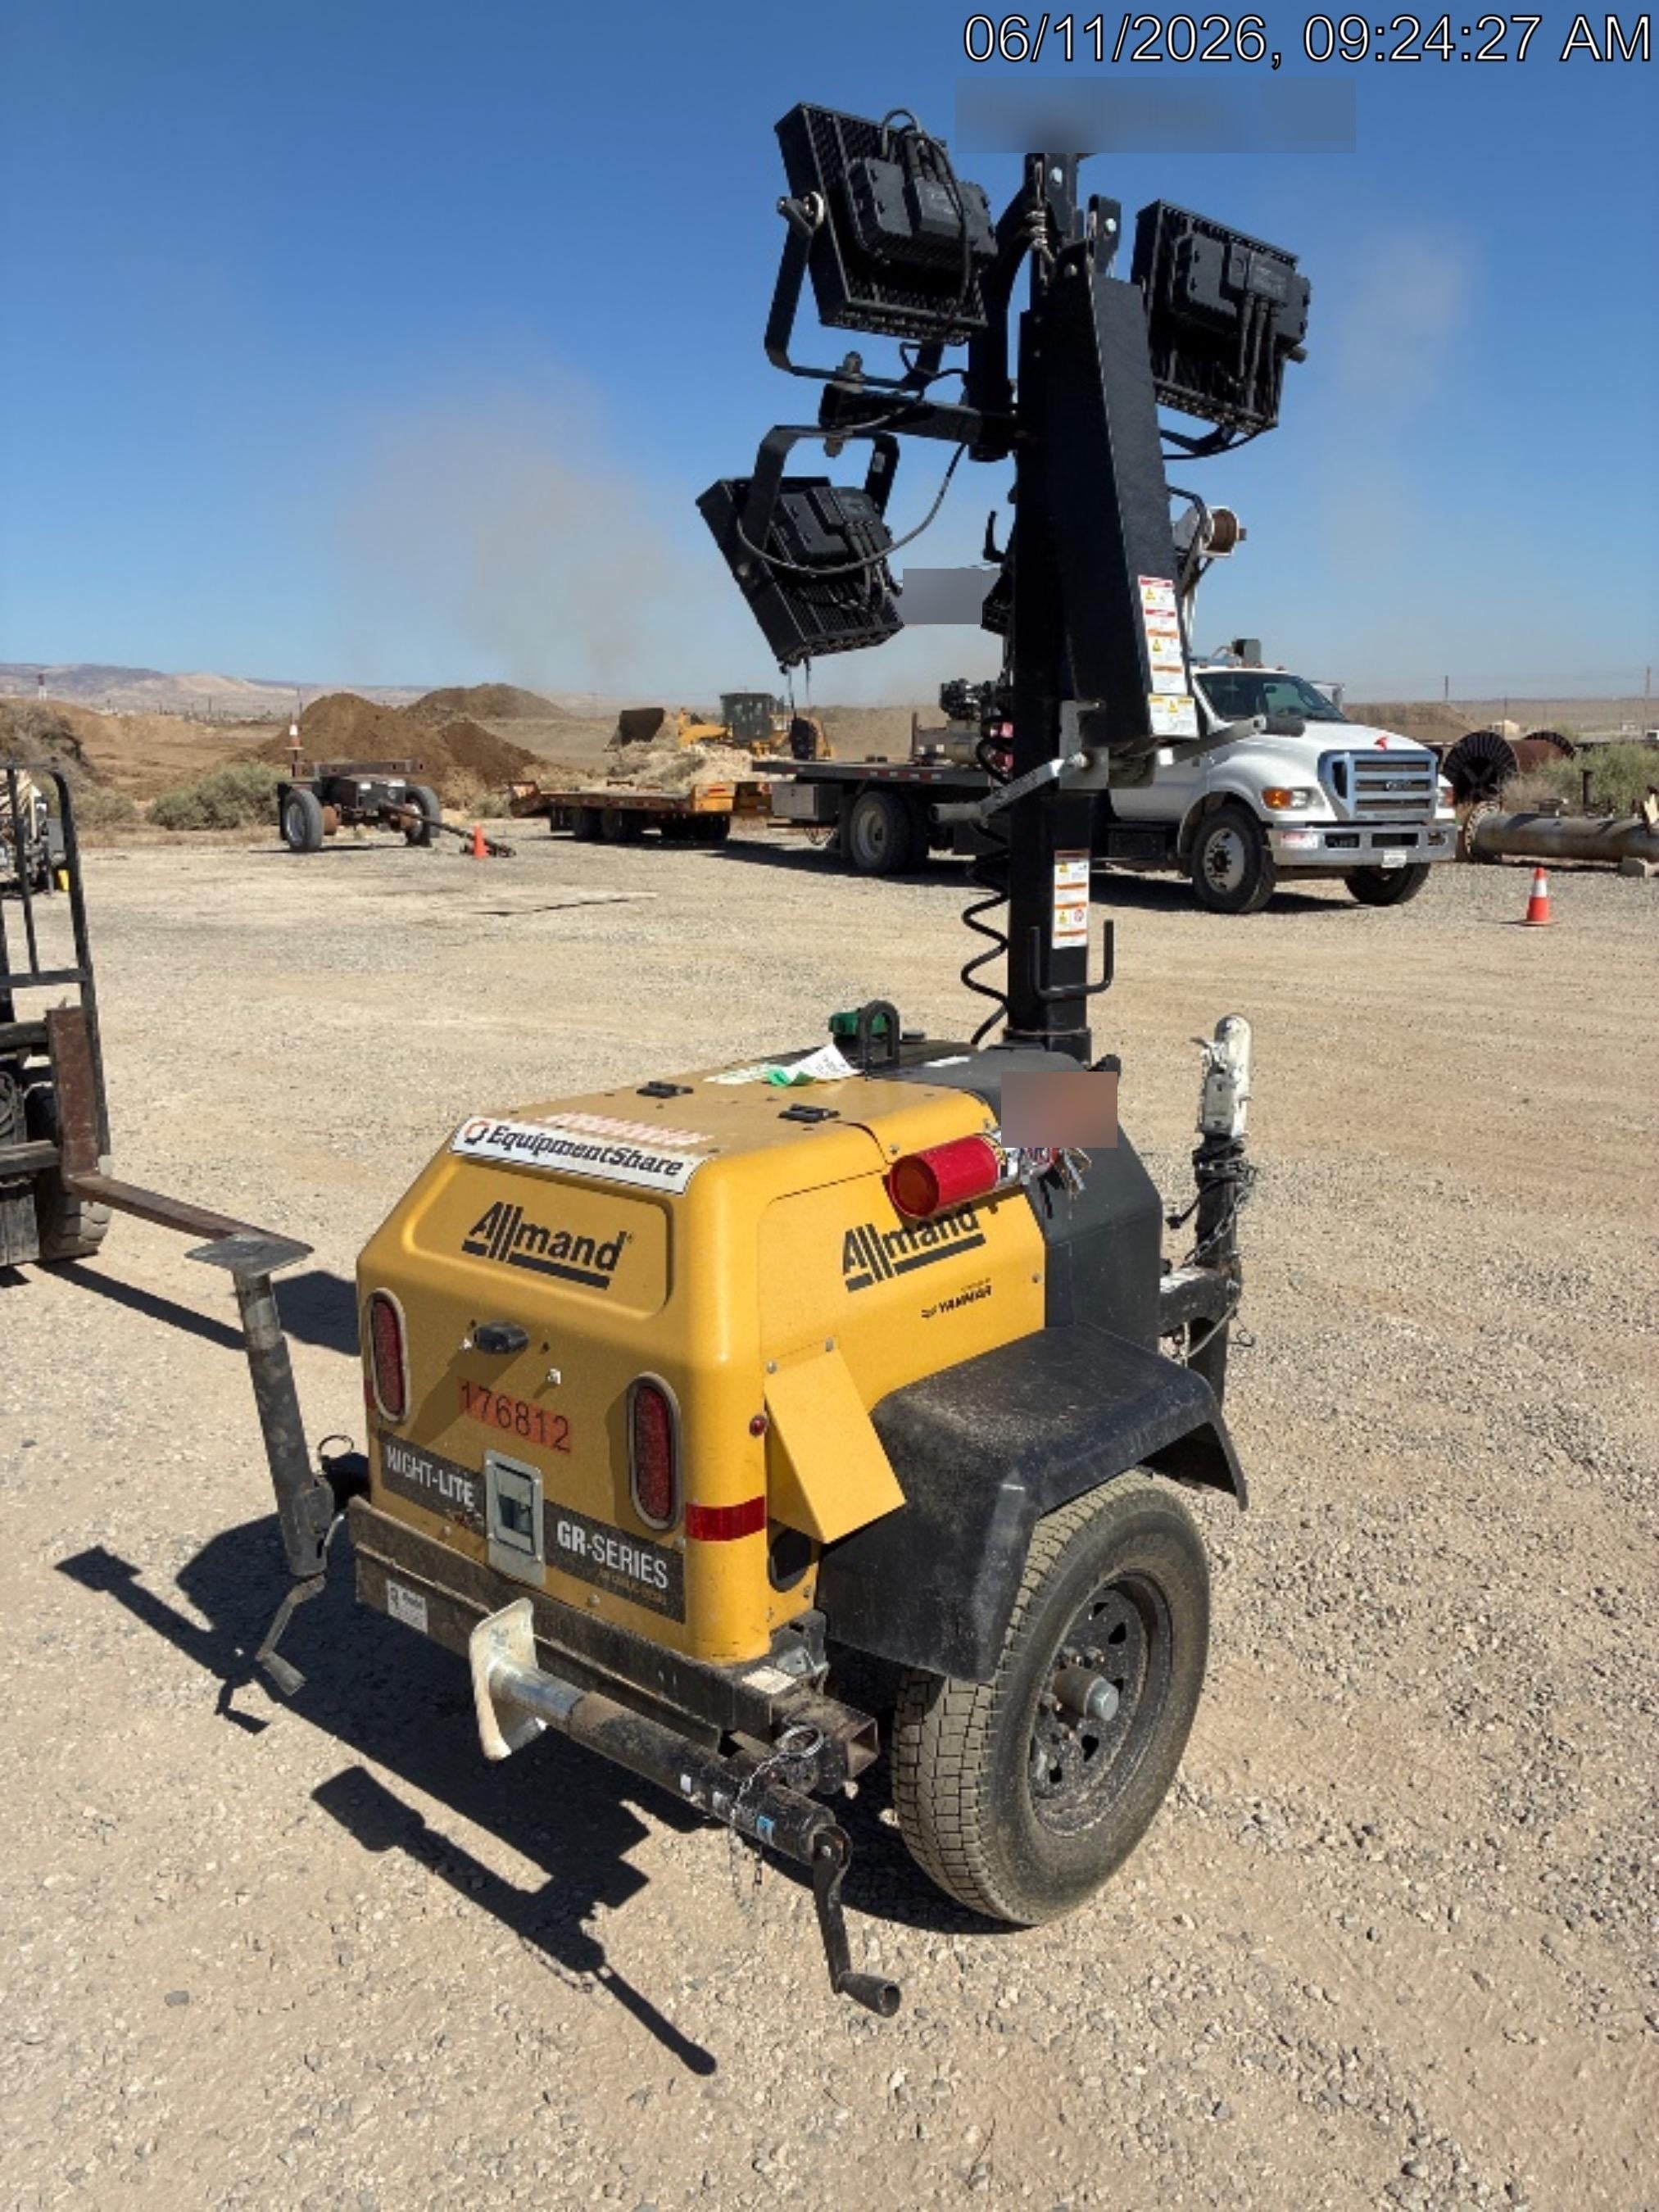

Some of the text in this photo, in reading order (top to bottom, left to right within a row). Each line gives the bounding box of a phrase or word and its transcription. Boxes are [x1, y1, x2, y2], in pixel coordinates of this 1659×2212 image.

[486, 1125, 684, 1176] EquipmentShare
[464, 1200, 628, 1273] Allmand
[459, 1380, 572, 1453] 176812
[385, 1444, 474, 1507] NIGHT-LITE
[555, 1519, 670, 1589] GR-SERIES
